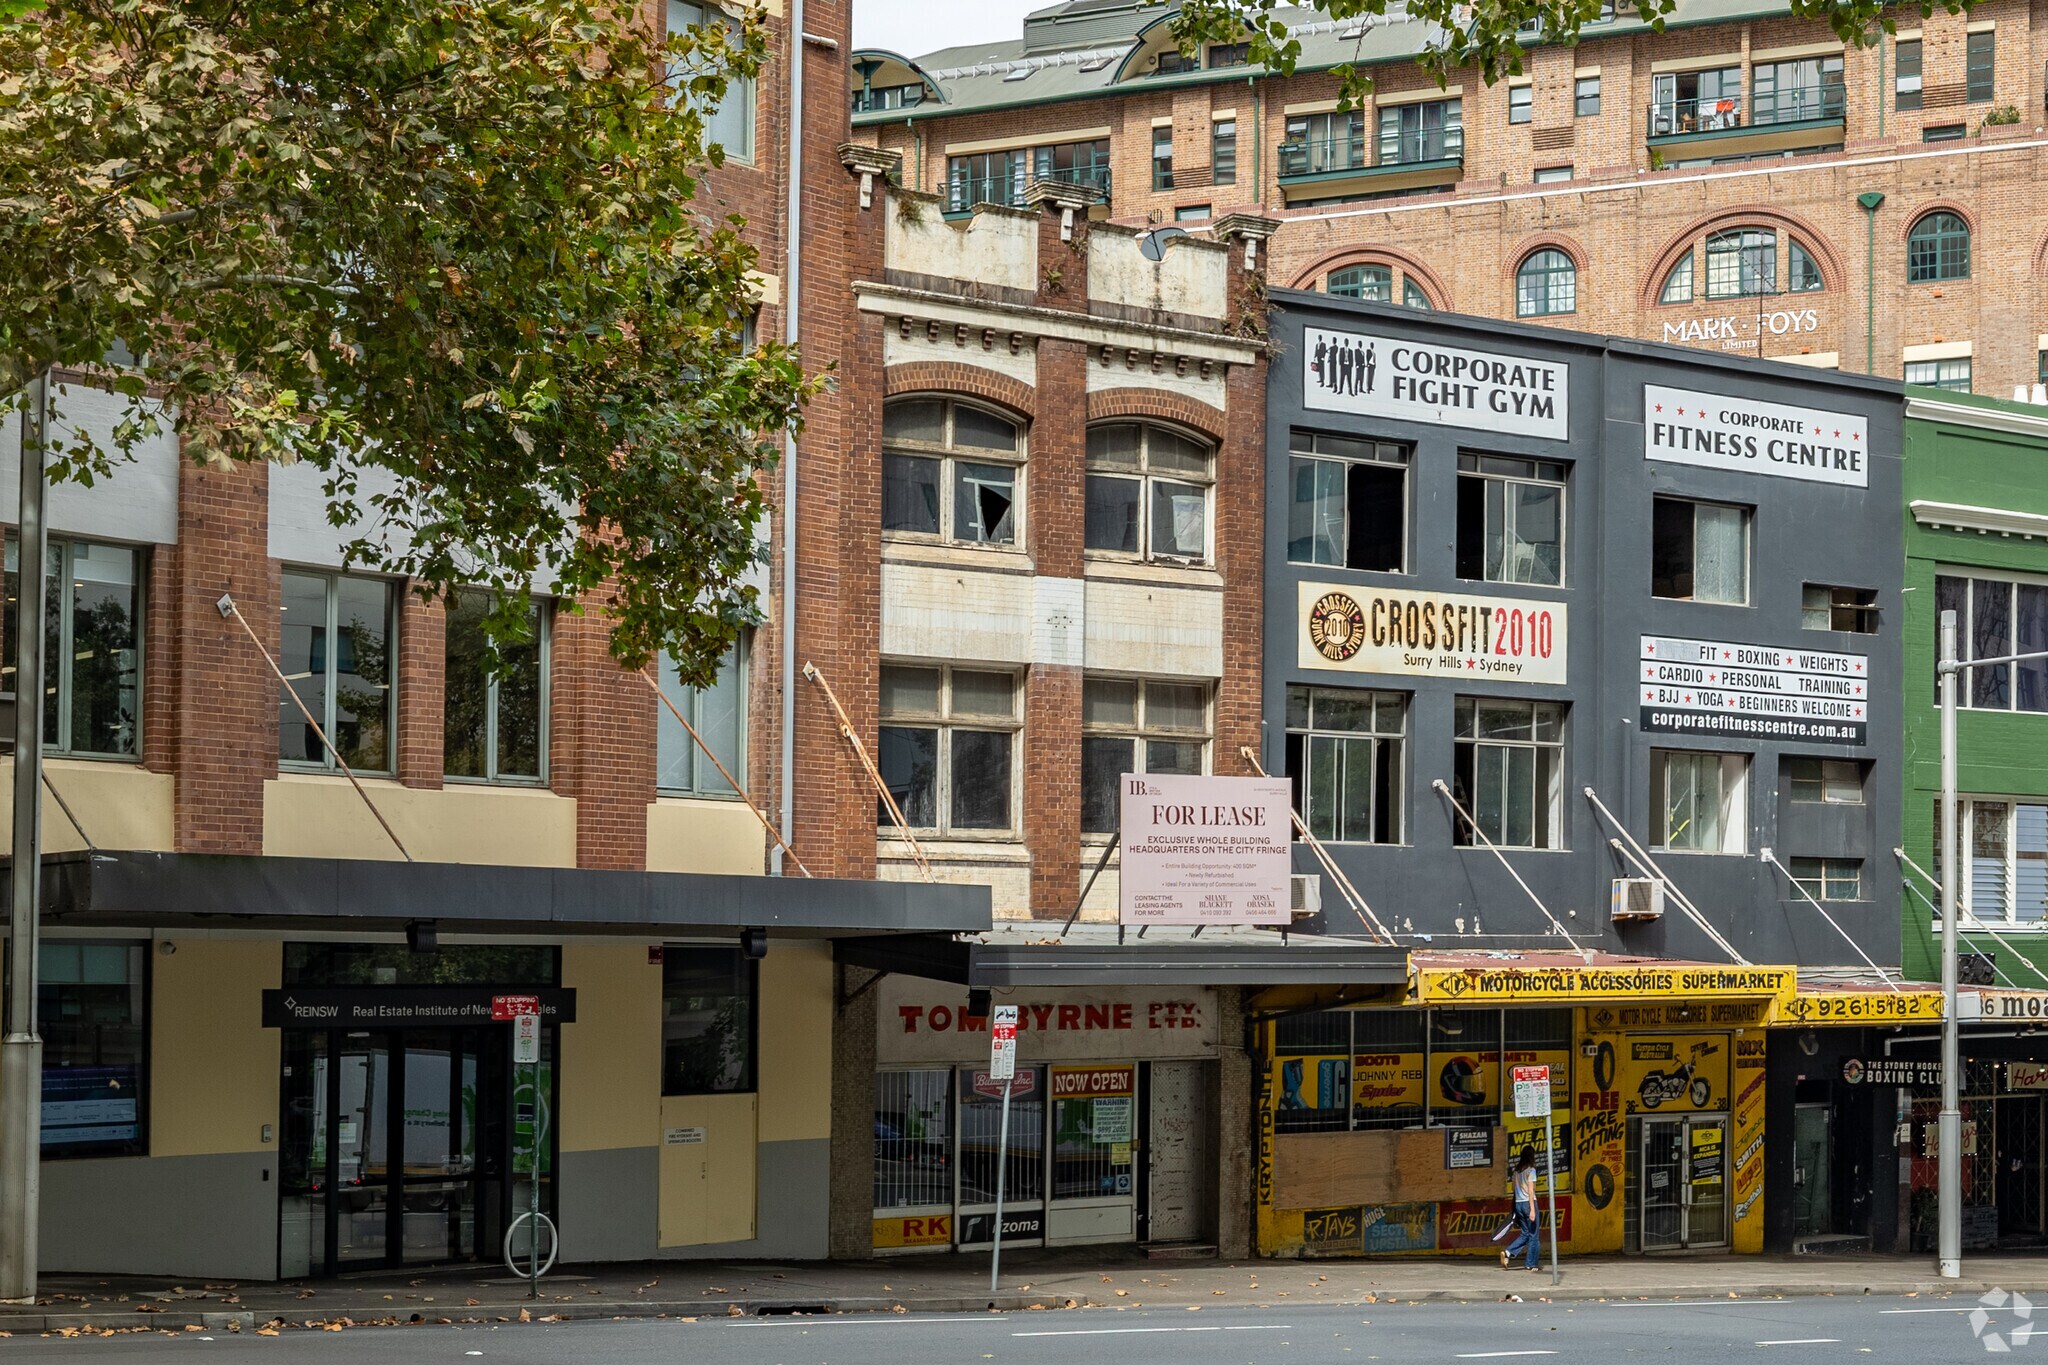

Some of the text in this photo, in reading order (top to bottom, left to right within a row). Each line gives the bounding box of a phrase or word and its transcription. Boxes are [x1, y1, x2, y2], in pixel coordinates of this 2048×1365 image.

[1663, 310, 1817, 343] MARK FOYS
[1722, 340, 1757, 350] LIMITED
[1391, 348, 1555, 392] CORPORATE
[1393, 375, 1555, 420] FIGHT GYM
[1719, 410, 1804, 434] CORPORATE
[1653, 422, 1861, 472] FITNESS CENTRE
[1325, 618, 1349, 638] 2010
[1403, 653, 1523, 675] Surry Hills Sydney
[1737, 650, 1780, 666] BOXING
[1799, 654, 1848, 672] WEIGHTS
[1659, 666, 1851, 695] CARDIO PERSONAL TRAINING
[1659, 689, 1851, 717] BJJ YOGA BEGINNERS WELCOME
[1652, 712, 1857, 739] corporatefitnesscentre.com.au
[1152, 804, 1266, 827] FOR LEASE
[1129, 845, 1287, 855] HEADQUARTERS ON THE CITY FRINGE
[1147, 835, 1271, 845] EXCLUSIVE WHOLE BUILDING
[1480, 974, 1575, 992] MOTORCYCLE
[1580, 974, 1673, 991] ACCESSORIES
[1682, 972, 1784, 990] SUPERMARKET
[295, 1006, 339, 1017] REINSW
[353, 1005, 377, 1017] Real
[379, 1005, 413, 1017] Estate
[415, 1005, 458, 1016] Institute
[460, 1004, 470, 1015] of
[538, 1004, 557, 1015] ales
[1016, 1003, 1132, 1031] BYRNE
[1618, 1008, 1640, 1024] MOTOR
[1641, 1008, 1661, 1024] CYCLE
[1711, 1003, 1759, 1021] SUPERMARKET
[1736, 1040, 1765, 1056] MX
[1355, 1055, 1400, 1066] BOOTS
[1867, 1061, 1942, 1070] THE SYDNEY HOOKE
[1055, 1072, 1129, 1093] NOW OPEN
[1353, 1070, 1422, 1082] JOHNNY REB
[1867, 1070, 1942, 1084] BOXING CLU
[1095, 1098, 1129, 1106] WARNING
[1579, 1091, 1619, 1111] FREE
[1259, 1060, 1272, 1206] KRYPTONITE
[1459, 1131, 1488, 1139] SHAZAM
[1513, 1126, 1561, 1144] WE AE
[1577, 1110, 1618, 1139] TYRE
[1577, 1122, 1624, 1160] FITTING
[1735, 1135, 1764, 1170] SMITH
[903, 1216, 949, 1237] RK
[1363, 1206, 1386, 1228] HUGE
